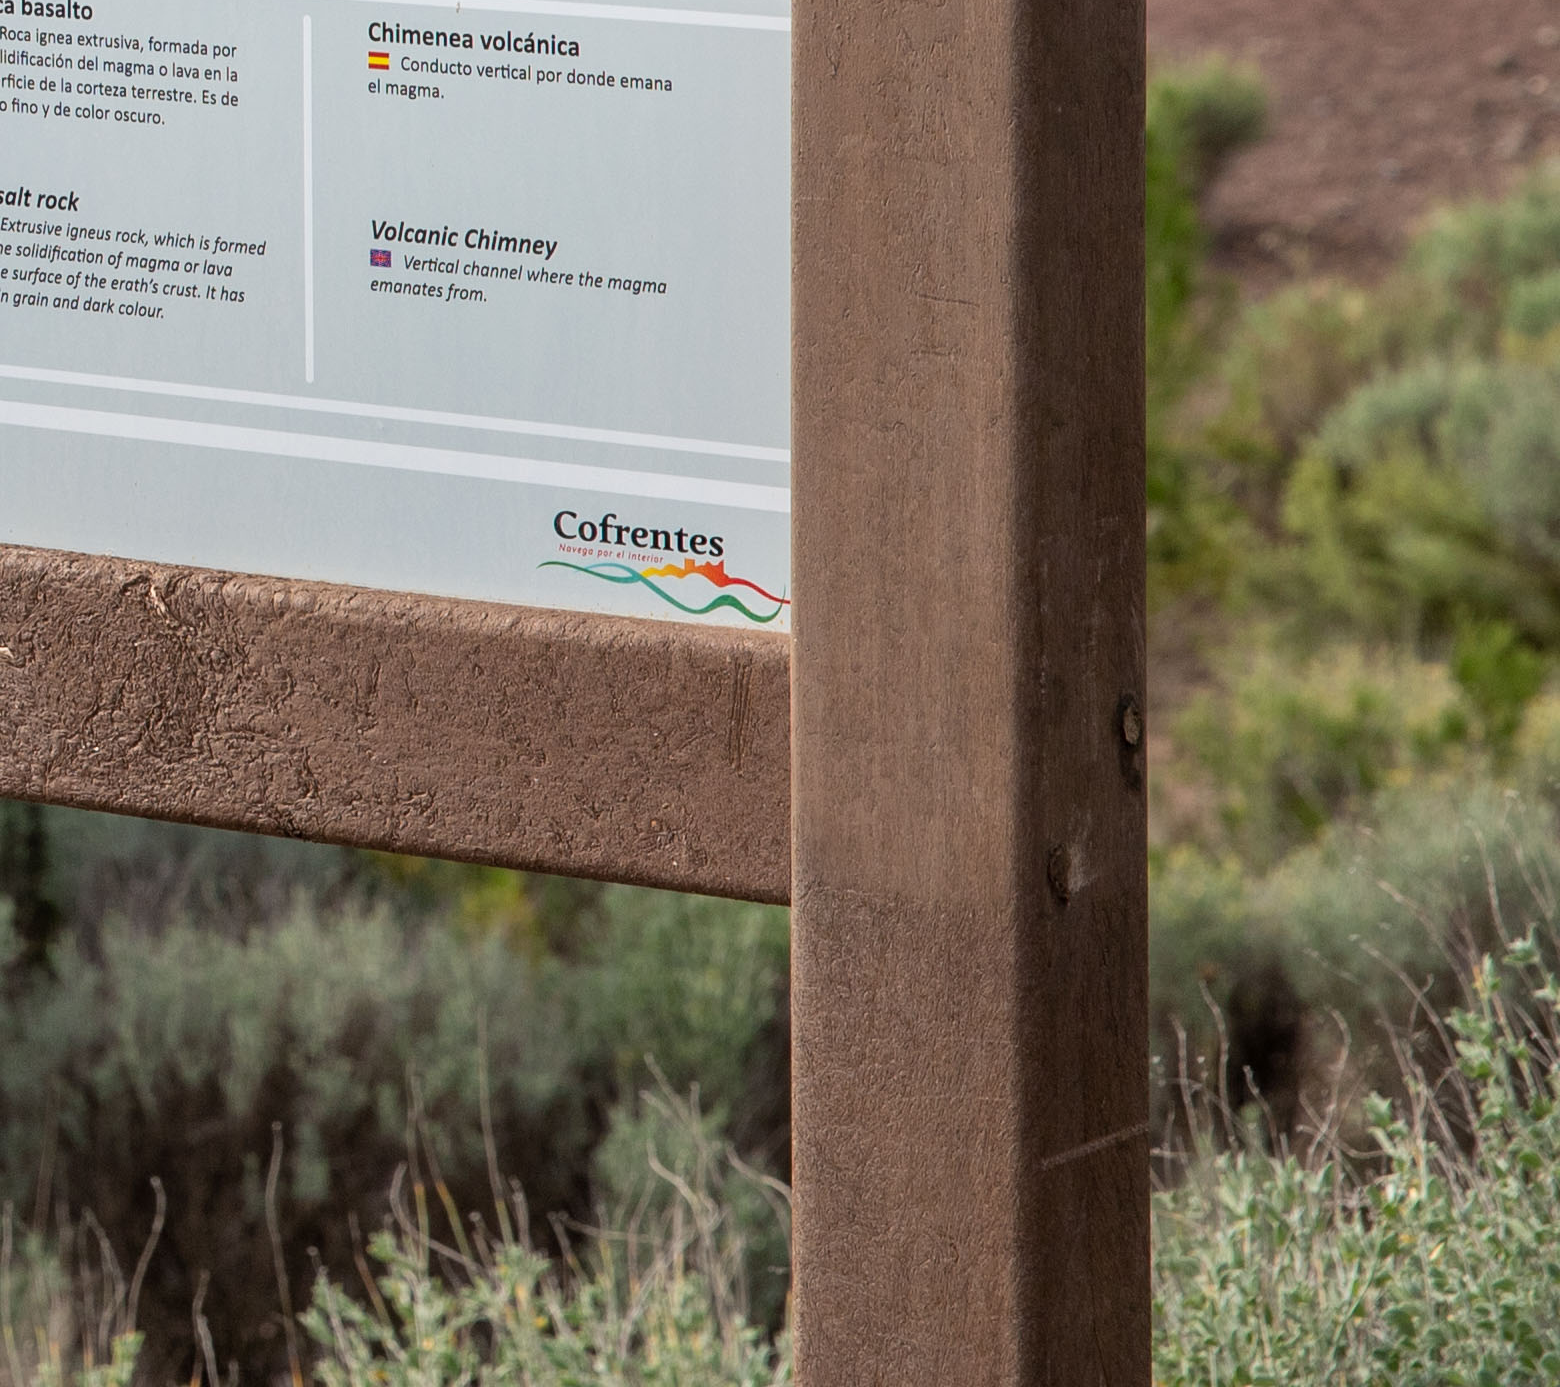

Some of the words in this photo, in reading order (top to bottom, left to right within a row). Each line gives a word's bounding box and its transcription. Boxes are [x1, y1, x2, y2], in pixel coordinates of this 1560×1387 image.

[0, 26, 31, 42] Roca
[36, 28, 72, 46] ignea
[77, 34, 144, 53] extrusiva,
[148, 36, 207, 55] formada
[213, 45, 237, 59] por
[369, 22, 473, 49] Chimenea
[480, 31, 579, 57] volcánica
[368, 78, 380, 94] el
[386, 83, 444, 100] magma.
[401, 56, 472, 76] Conducto
[476, 64, 531, 80] vertical
[537, 70, 562, 85] por
[567, 68, 615, 87] donde
[620, 76, 672, 91] emana
[37, 191, 79, 212] rock
[0, 217, 62, 236] Extrusive
[66, 223, 111, 241] igneus
[115, 229, 148, 247] rock,
[154, 232, 195, 249] which
[199, 235, 210, 250] is
[212, 236, 266, 256] formed
[372, 220, 458, 247] Volcanic
[465, 228, 558, 260] Chimney
[370, 280, 443, 298] emanates
[445, 283, 487, 302] from.
[404, 255, 459, 274] Vertical
[463, 260, 523, 280] channel
[527, 267, 574, 285] where
[579, 271, 603, 288] the
[608, 278, 667, 295] magma
[554, 511, 723, 557] Cofrentes
[559, 543, 594, 557] Navega
[597, 550, 613, 558] por
[616, 550, 624, 558] el
